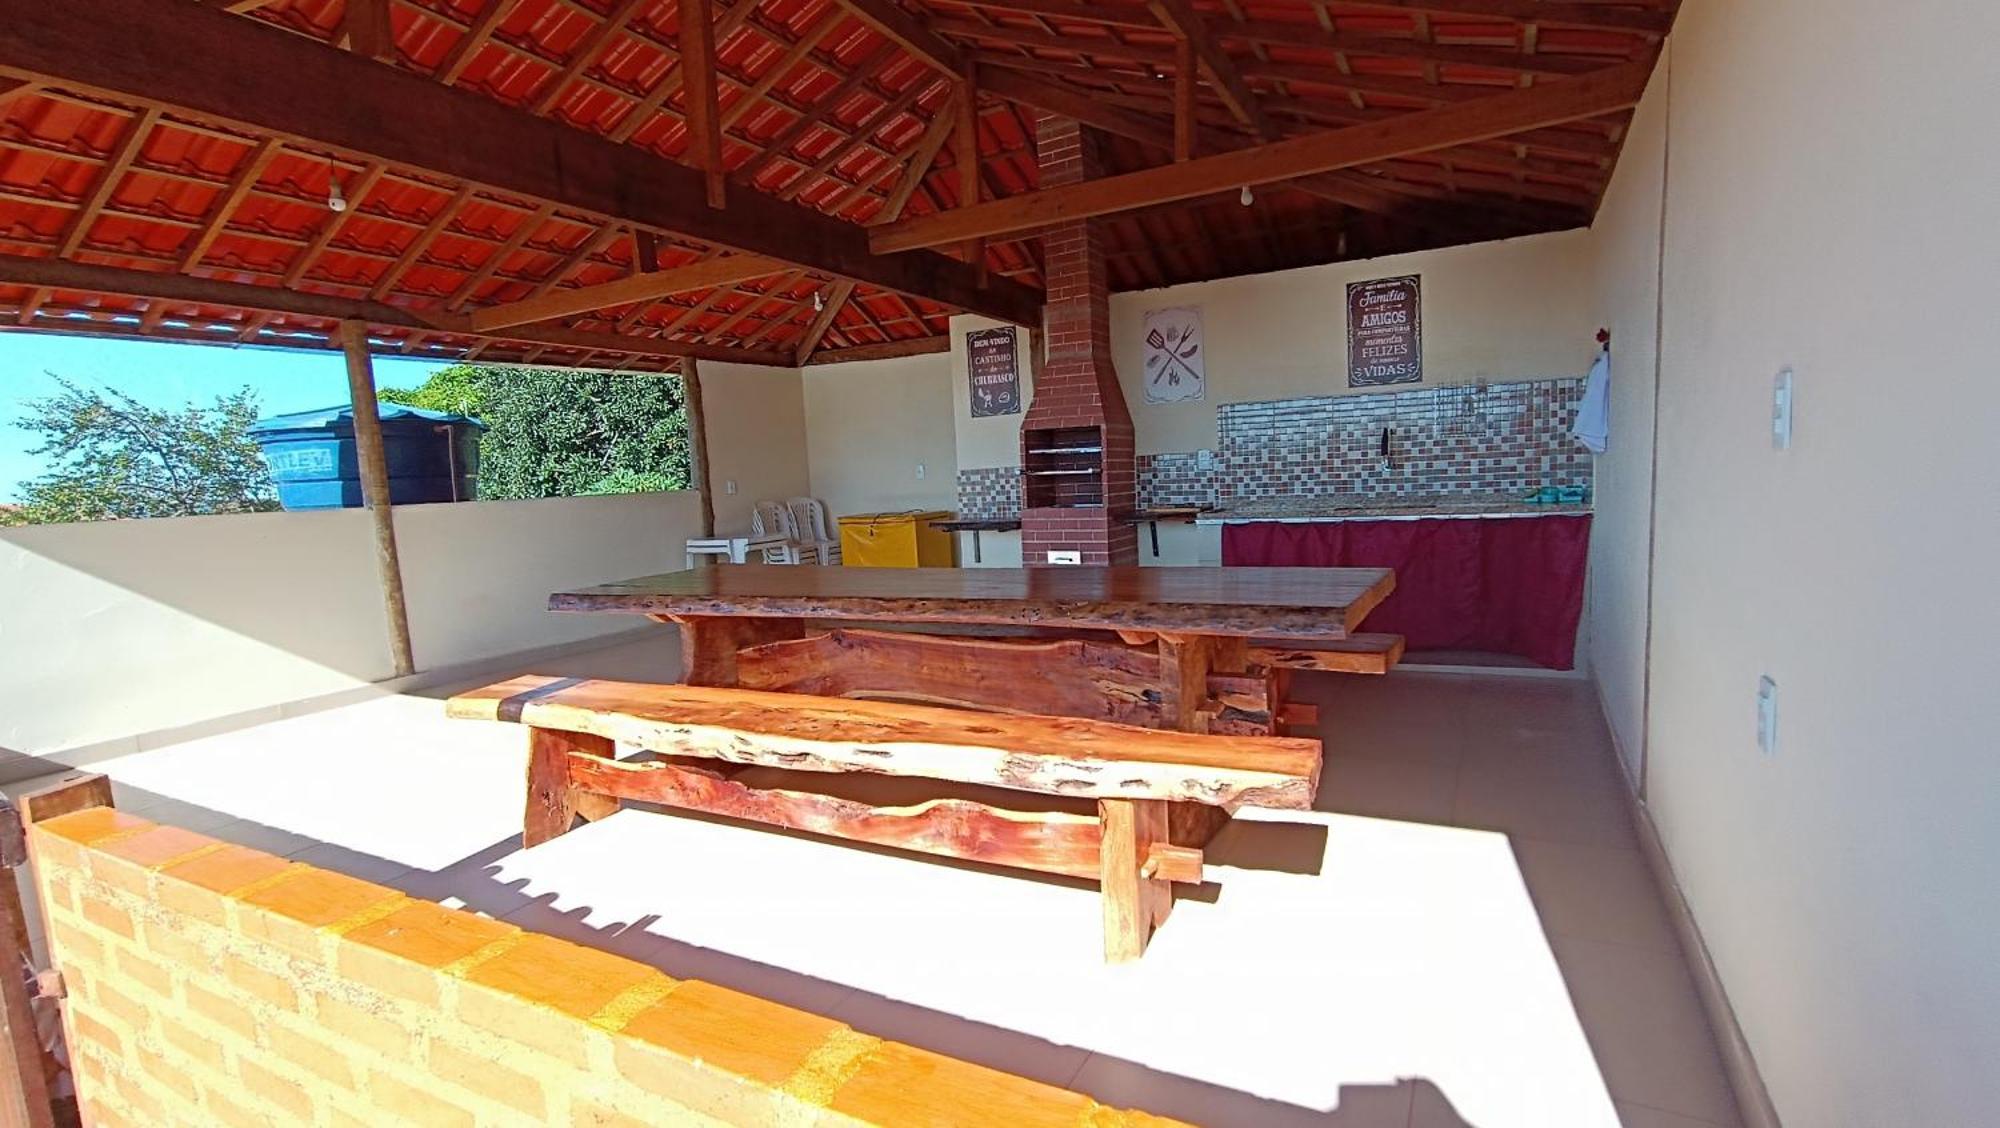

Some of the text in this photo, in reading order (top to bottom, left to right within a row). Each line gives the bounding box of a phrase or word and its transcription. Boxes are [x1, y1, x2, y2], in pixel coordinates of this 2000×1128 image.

[1361, 310, 1406, 326] AMIGOS
[974, 336, 1010, 348] BEM VINDO
[1362, 344, 1407, 358] FELIZES
[975, 353, 1011, 364] CANTINHO
[1364, 364, 1406, 376] VIDAS
[974, 373, 1014, 385] CHURRASCO
